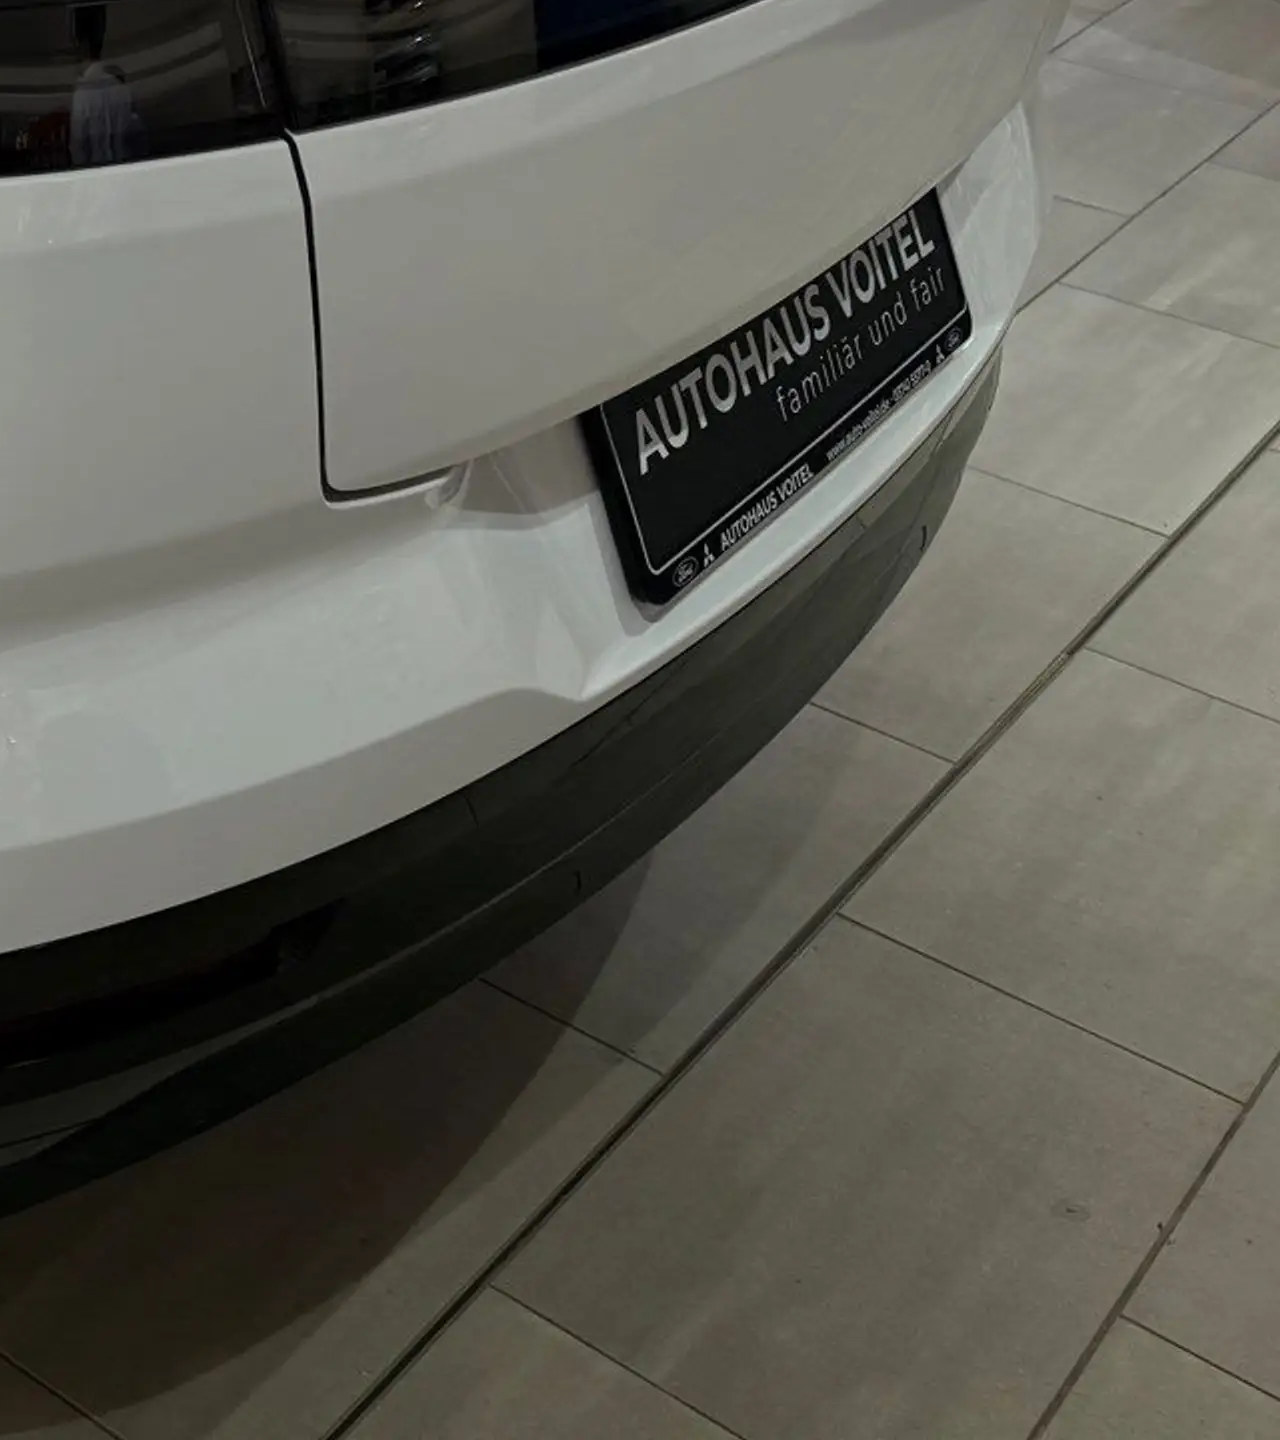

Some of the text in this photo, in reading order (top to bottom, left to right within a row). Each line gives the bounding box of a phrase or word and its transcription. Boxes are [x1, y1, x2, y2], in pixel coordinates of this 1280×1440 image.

[634, 208, 937, 476] AUTOHAUS VOITEL
[775, 333, 864, 422] familiär
[867, 290, 908, 347] und
[909, 266, 945, 312] fair
[719, 491, 778, 552] AUTOHAUS
[775, 463, 815, 502] VOITEL
